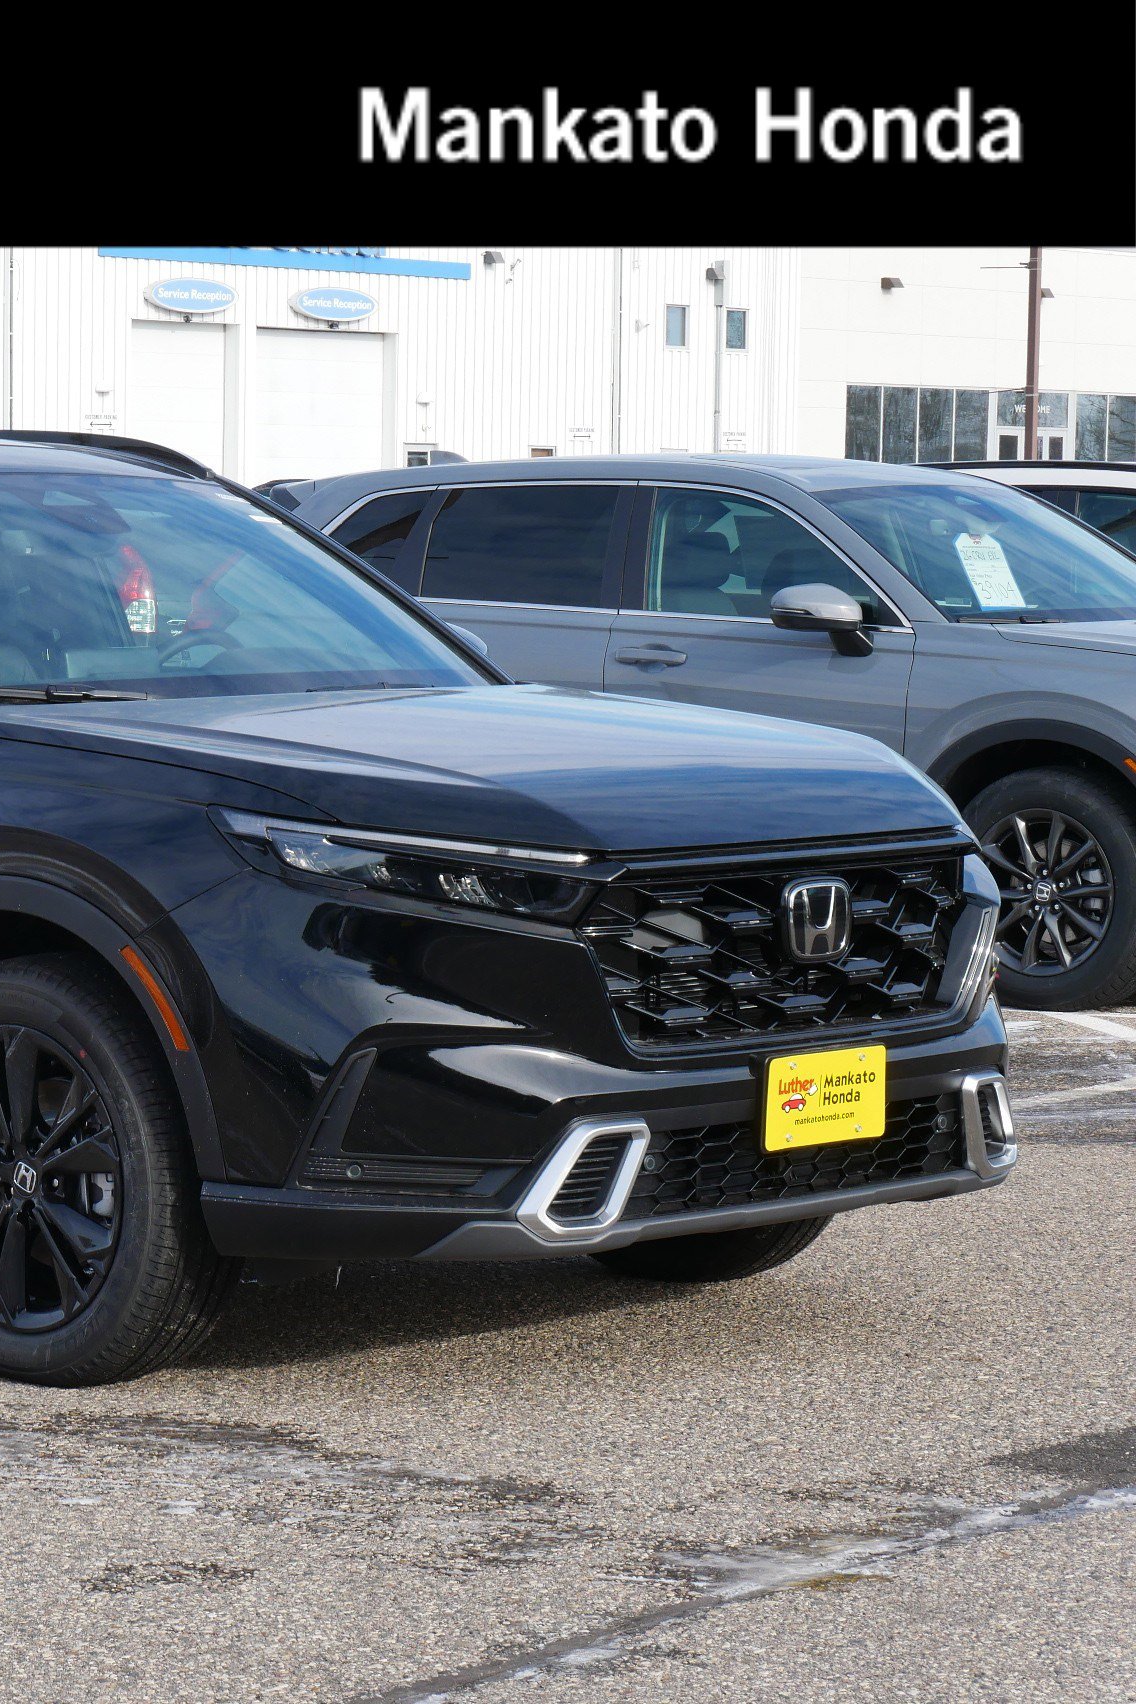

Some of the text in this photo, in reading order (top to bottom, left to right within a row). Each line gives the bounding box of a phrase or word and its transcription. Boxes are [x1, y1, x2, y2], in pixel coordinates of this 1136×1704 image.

[158, 288, 232, 303] Service Reception
[302, 296, 372, 311] Service Reception
[1014, 404, 1050, 414] WEME
[778, 1077, 815, 1095] Luther
[823, 1070, 876, 1089] Mankato
[823, 1088, 861, 1106] Honda
[794, 1111, 855, 1126] mankatohonda.com
